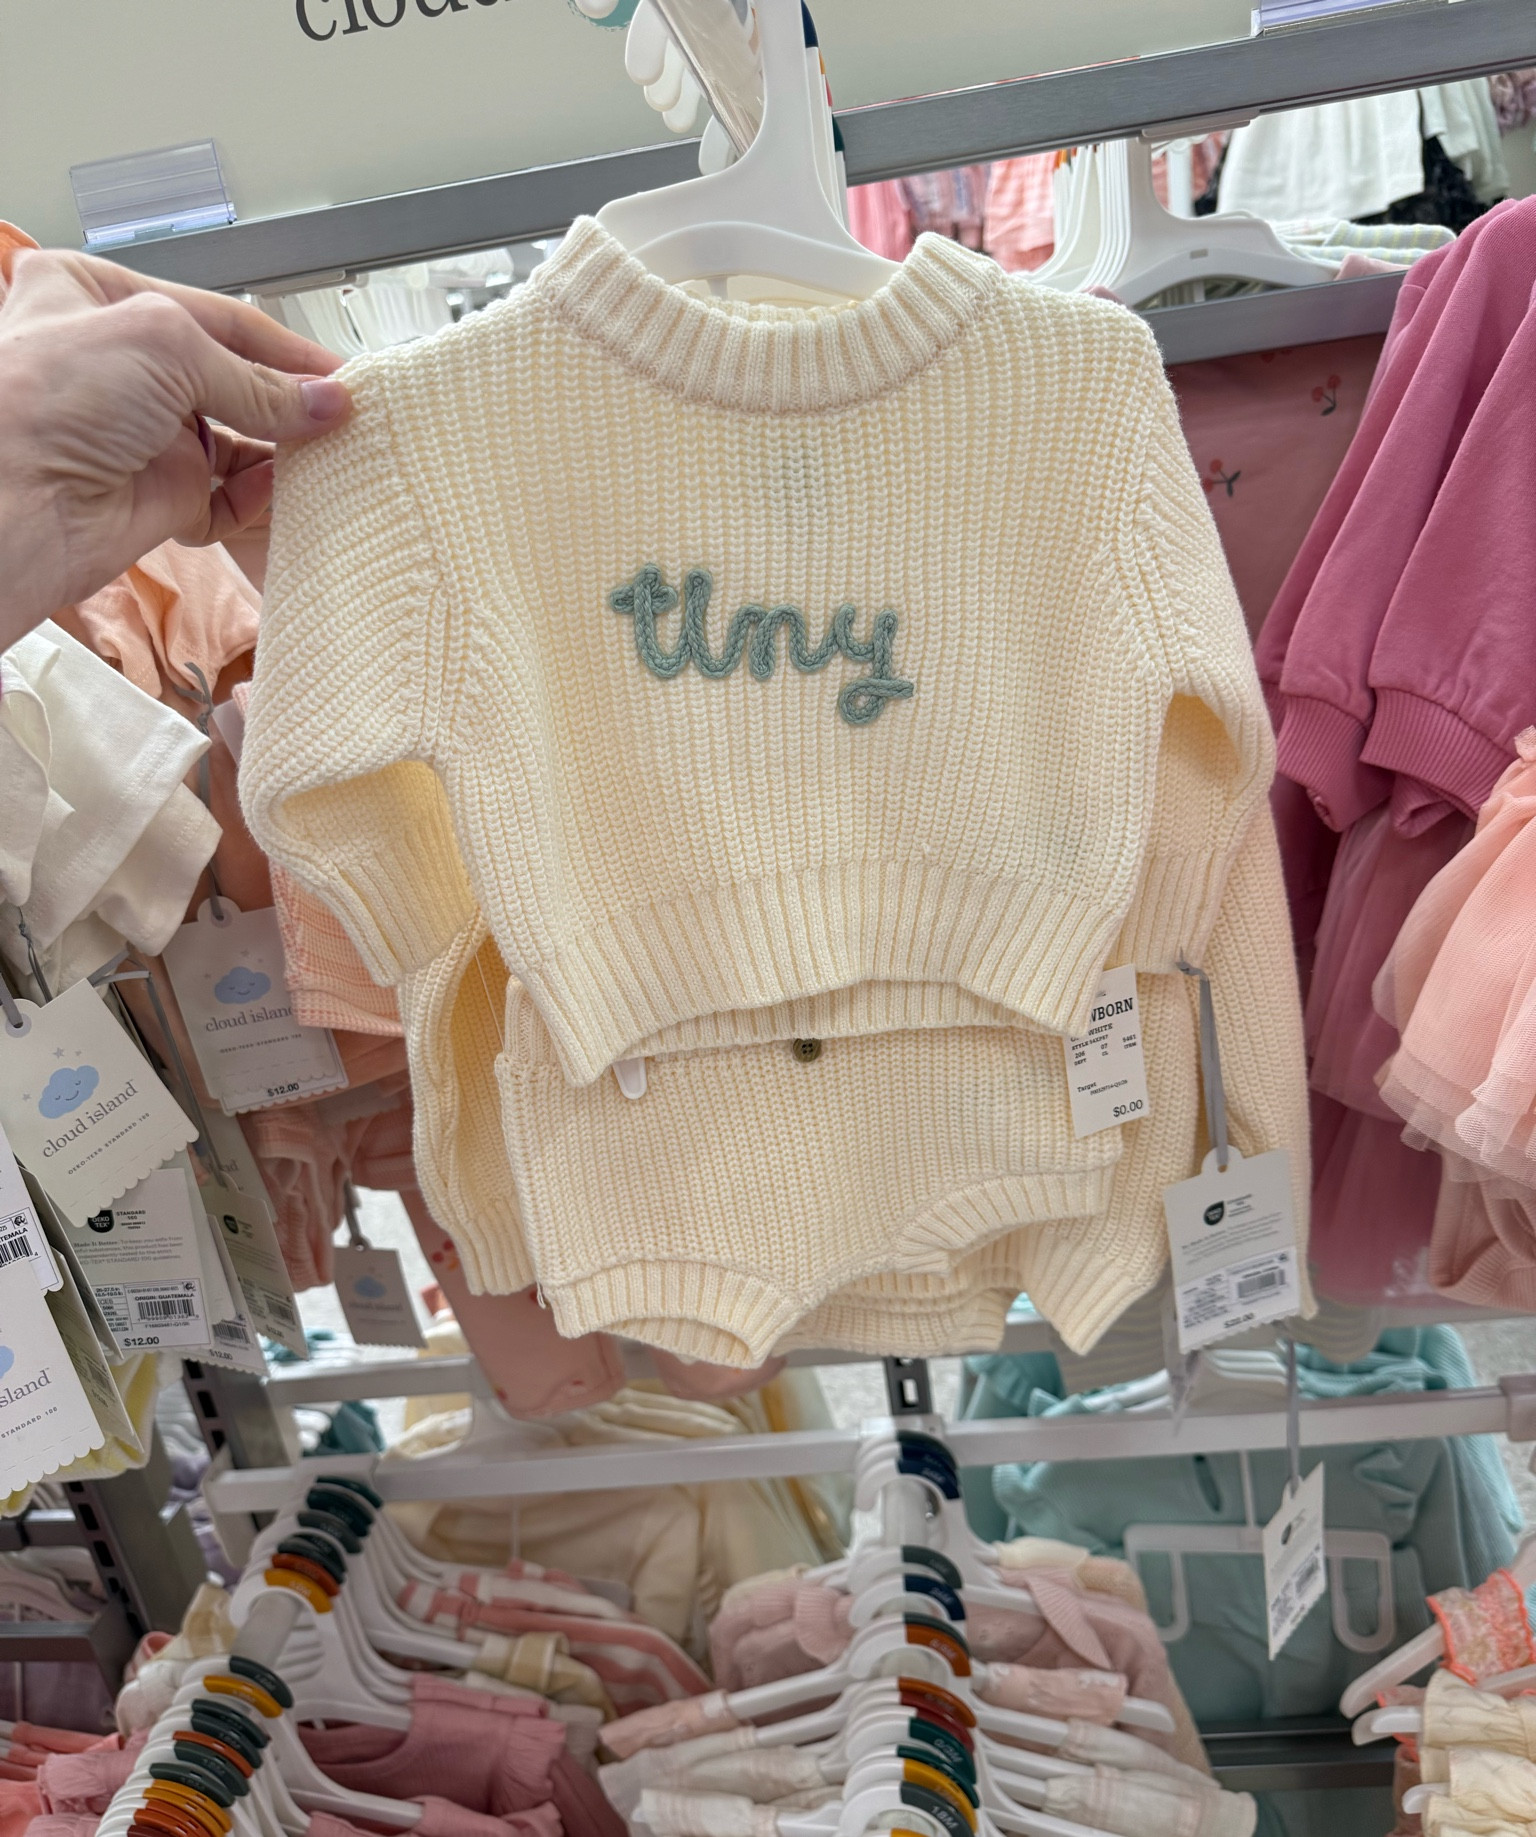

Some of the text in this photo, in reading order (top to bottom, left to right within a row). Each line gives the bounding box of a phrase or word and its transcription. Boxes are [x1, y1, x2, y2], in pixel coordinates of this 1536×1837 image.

[1090, 998, 1133, 1022] WBORN
[205, 1011, 248, 1032] cloud
[1088, 1023, 1113, 1036] WHITE
[267, 1083, 299, 1097] $12.00
[1113, 1100, 1143, 1117] $0.00
[42, 1118, 89, 1158] cloud
[105, 1122, 137, 1147] STANDARD
[124, 1336, 160, 1346] $12.00
[0, 1370, 52, 1408] sland
[1, 1415, 42, 1439] STANDARD
[931, 1806, 959, 1828] 18M
